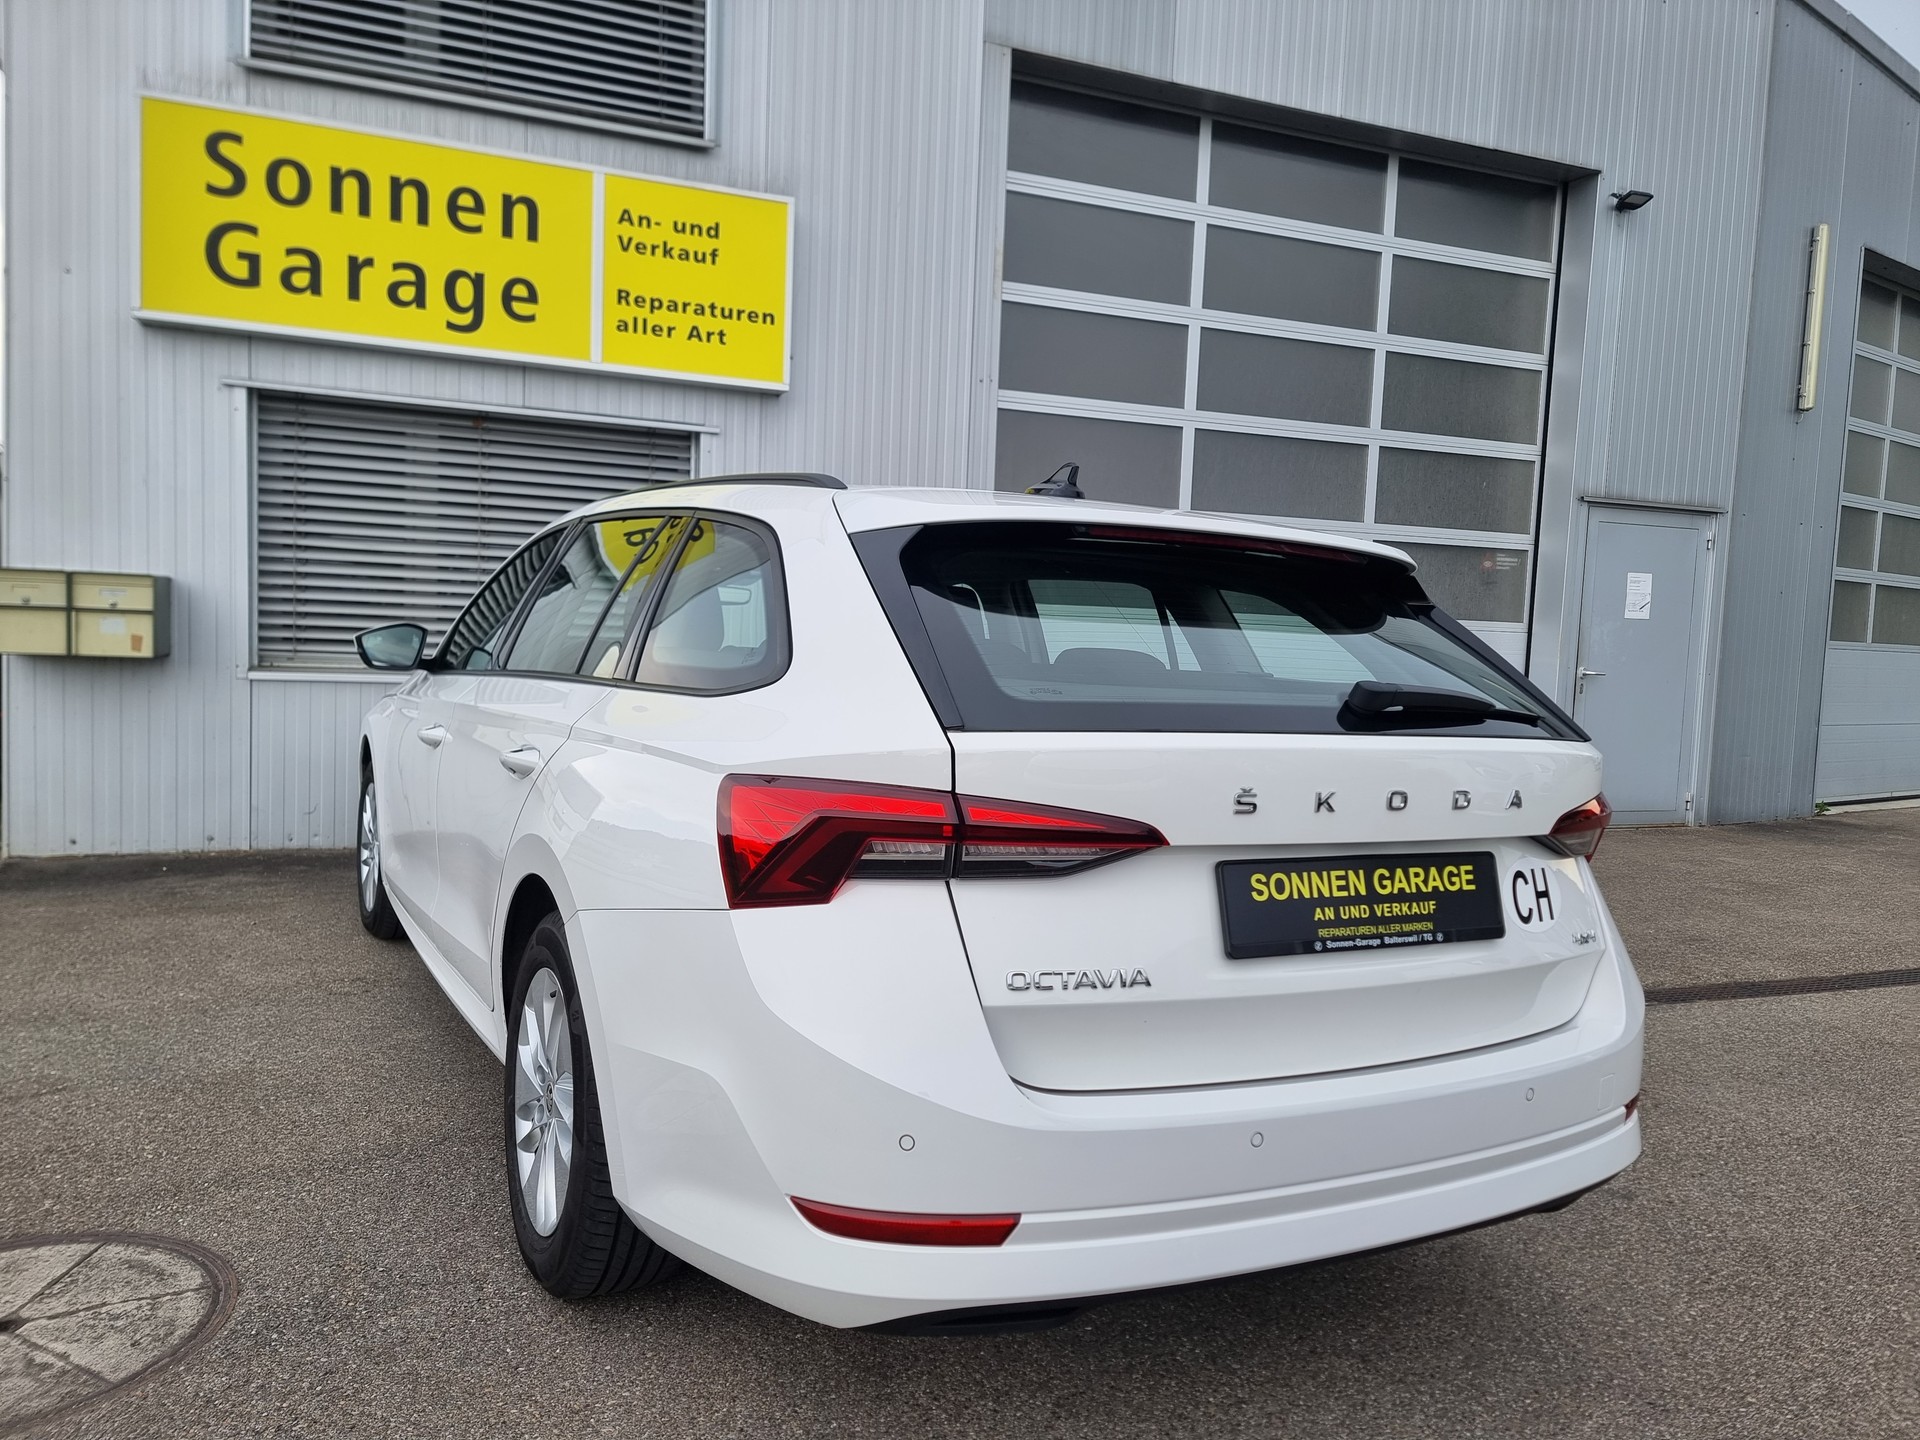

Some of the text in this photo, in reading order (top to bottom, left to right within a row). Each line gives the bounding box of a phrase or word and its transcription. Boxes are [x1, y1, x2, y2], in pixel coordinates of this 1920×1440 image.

[204, 131, 541, 243] Sonnen
[617, 208, 721, 240] An- und
[617, 234, 720, 266] Verkauf
[204, 221, 541, 334] Garage
[616, 288, 776, 326] Reparaturen
[616, 316, 727, 346] aller Art
[1233, 786, 1523, 814] ŠKODA
[1250, 865, 1476, 902] SONNEN GARAGE
[1512, 867, 1554, 924] CH
[1314, 901, 1437, 921] AN UND VERKAUF
[1318, 921, 1434, 938] REPARATUREN ALLER MARKEN
[1326, 938, 1381, 949] Sonnen-Garage
[1006, 967, 1152, 991] OCTAVIA
